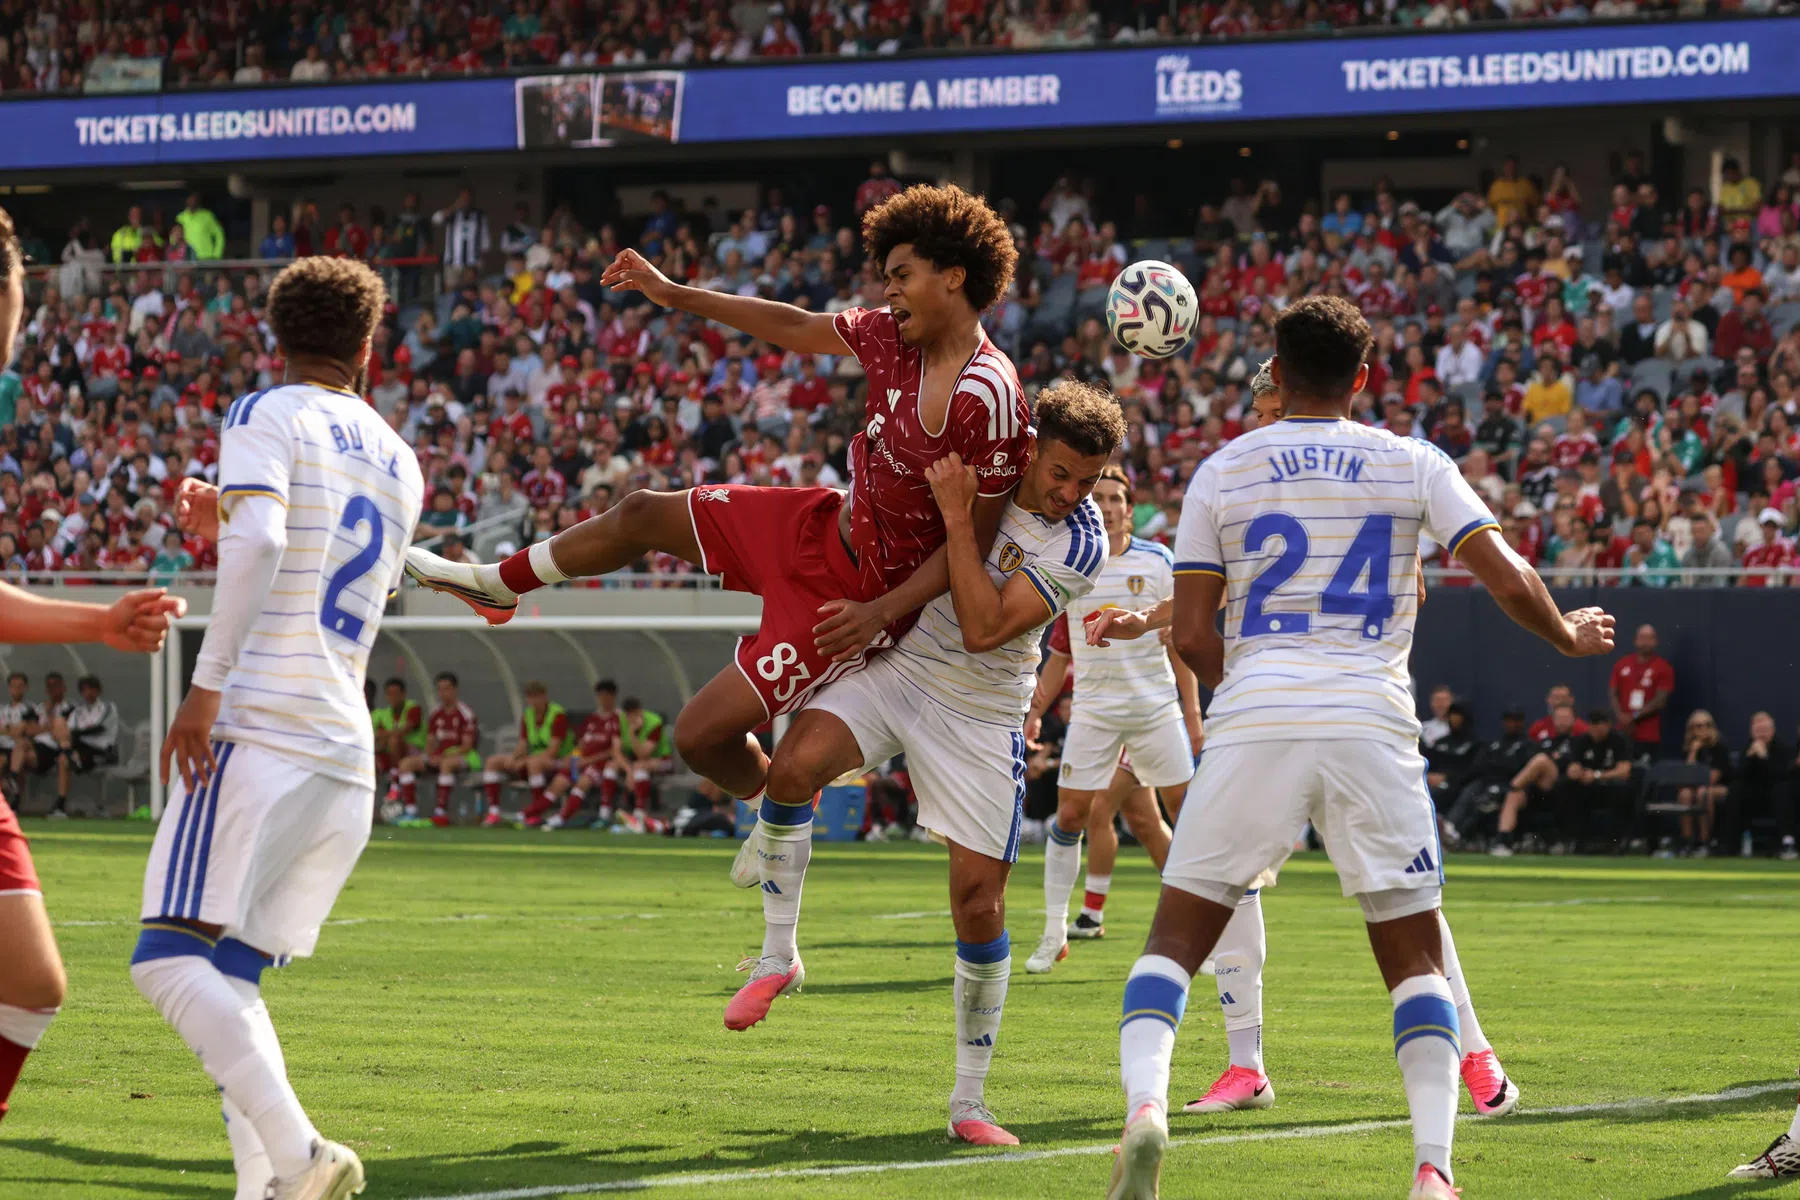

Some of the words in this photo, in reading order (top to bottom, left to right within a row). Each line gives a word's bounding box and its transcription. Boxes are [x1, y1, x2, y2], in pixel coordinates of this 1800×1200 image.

[1156, 69, 1243, 103] LEEDS
[1342, 42, 1749, 91] TICKETS.LEEDSUNITED.COM
[787, 82, 906, 116] BECOME
[910, 80, 933, 111] A
[937, 74, 1061, 108] MEMBER
[76, 102, 416, 146] TICKETS.LEEDSUNITED.COM
[1268, 447, 1365, 483] JUSTIN
[320, 493, 384, 643] 2
[1240, 511, 1396, 641] 24
[756, 642, 811, 702] 83
